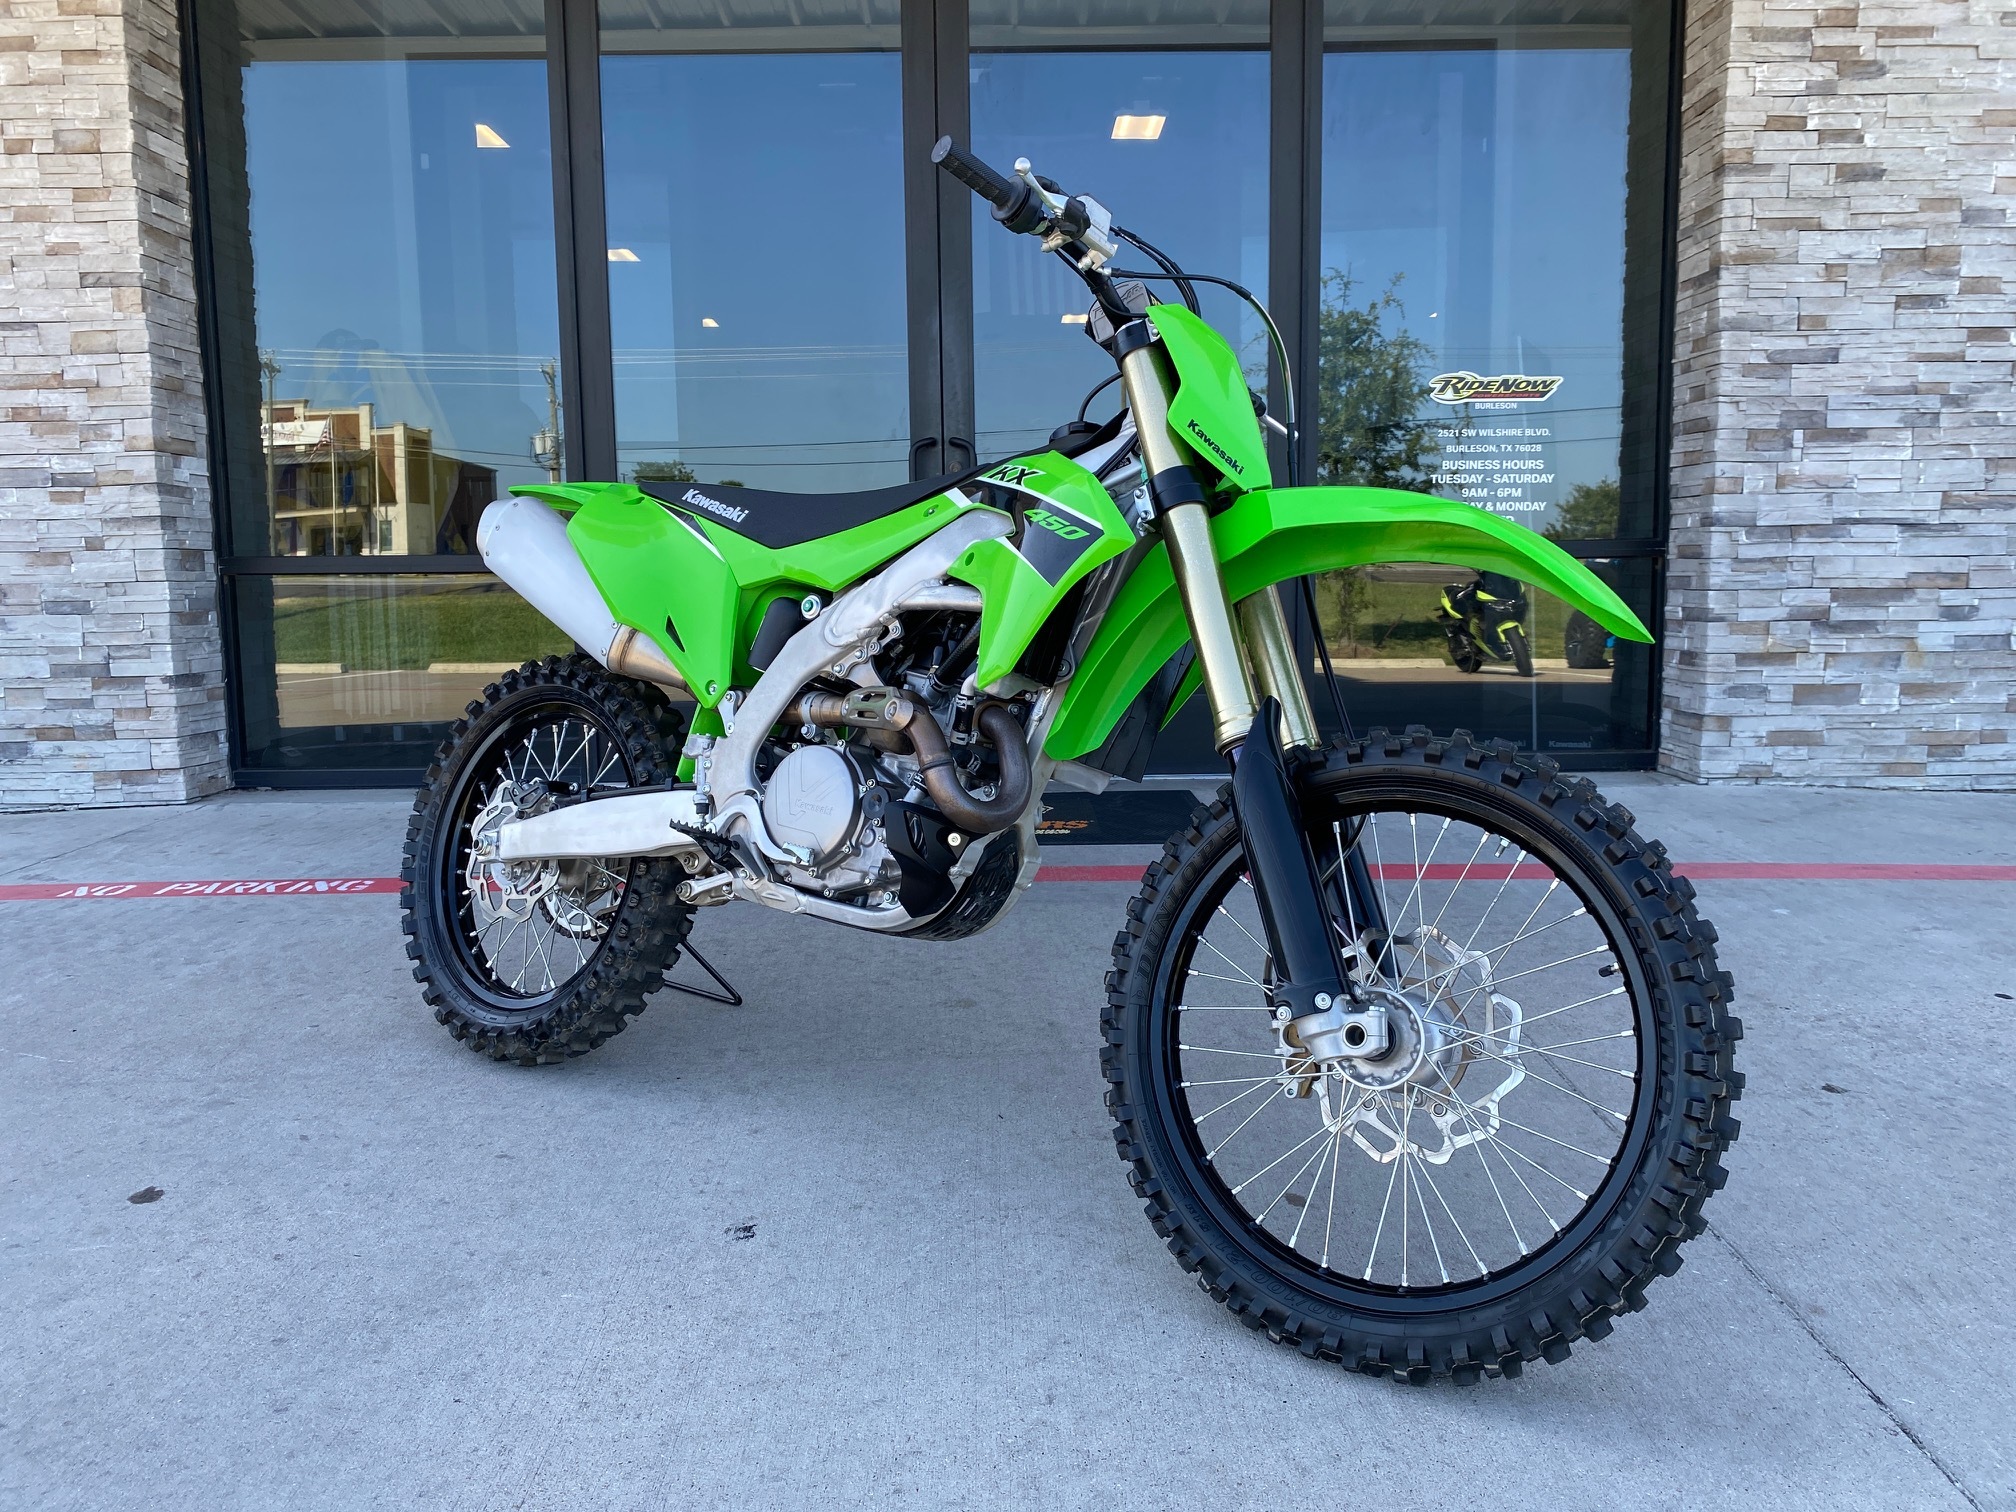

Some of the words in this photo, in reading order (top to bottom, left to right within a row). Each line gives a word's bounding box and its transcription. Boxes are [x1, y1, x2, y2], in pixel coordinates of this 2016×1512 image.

[1474, 402, 1517, 410] BURLESON
[1437, 429, 1459, 437] 2521
[1461, 429, 1477, 437] SW
[1478, 428, 1523, 437] WILSHIRE
[1525, 428, 1551, 436] BLVD.
[1186, 419, 1245, 475] Kawasaki
[1446, 444, 1499, 453] BURLESON,
[1500, 444, 1513, 452] TX
[1514, 444, 1542, 452] 76028
[1442, 460, 1500, 470] BUSINESS
[1502, 460, 1544, 470] HOURS
[988, 465, 1043, 487] KX
[1430, 474, 1484, 484] TUESDAY
[1493, 474, 1555, 484] SATURDAY
[1461, 488, 1488, 498] 9AM
[1497, 488, 1522, 497] 6PM
[681, 488, 749, 523] Kawasaki
[1485, 501, 1494, 511] &
[1496, 501, 1547, 511] MONDAY
[1023, 509, 1090, 540] 450
[795, 799, 834, 817] Kawasaki
[56, 884, 137, 898] NO
[153, 880, 376, 896] PARKING
[1137, 839, 1216, 983] DUNLOP
[1213, 1239, 1346, 1321] 80/100-21
